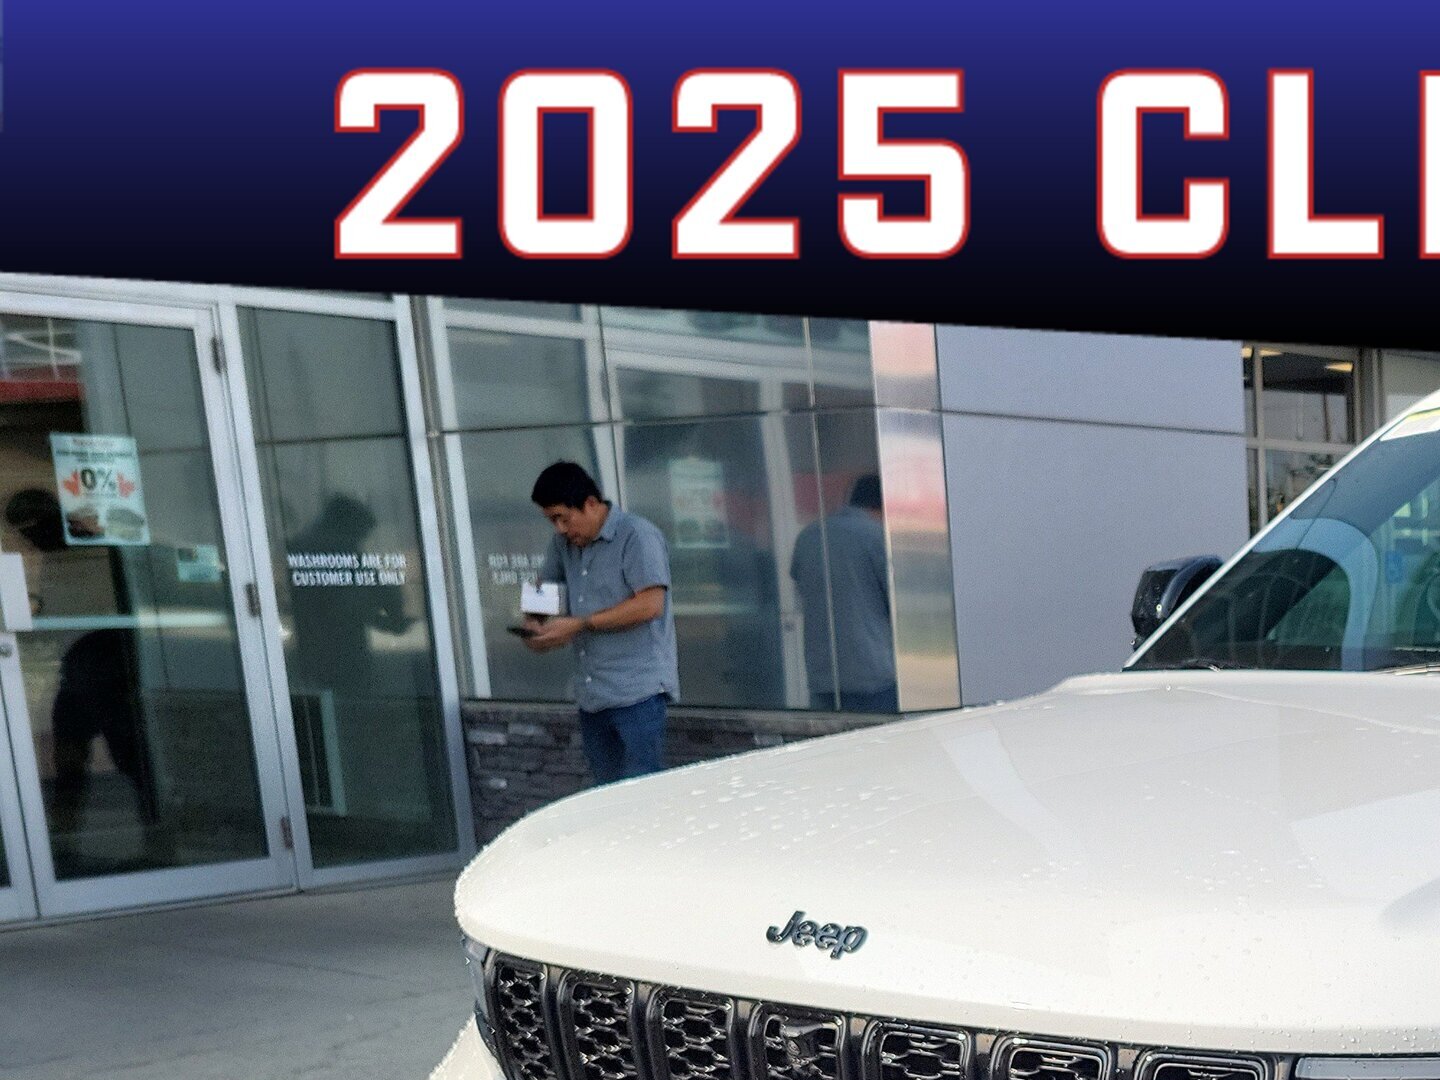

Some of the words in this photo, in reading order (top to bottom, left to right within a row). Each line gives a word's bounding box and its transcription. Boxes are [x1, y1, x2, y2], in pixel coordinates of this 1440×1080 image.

[81, 465, 117, 491] 0%
[287, 553, 360, 569] WASHROOMS
[361, 553, 381, 569] ARE
[292, 570, 354, 586] CUSTOMER
[354, 570, 378, 586] USE
[378, 570, 406, 586] ONLY
[766, 910, 868, 960] Jeep
